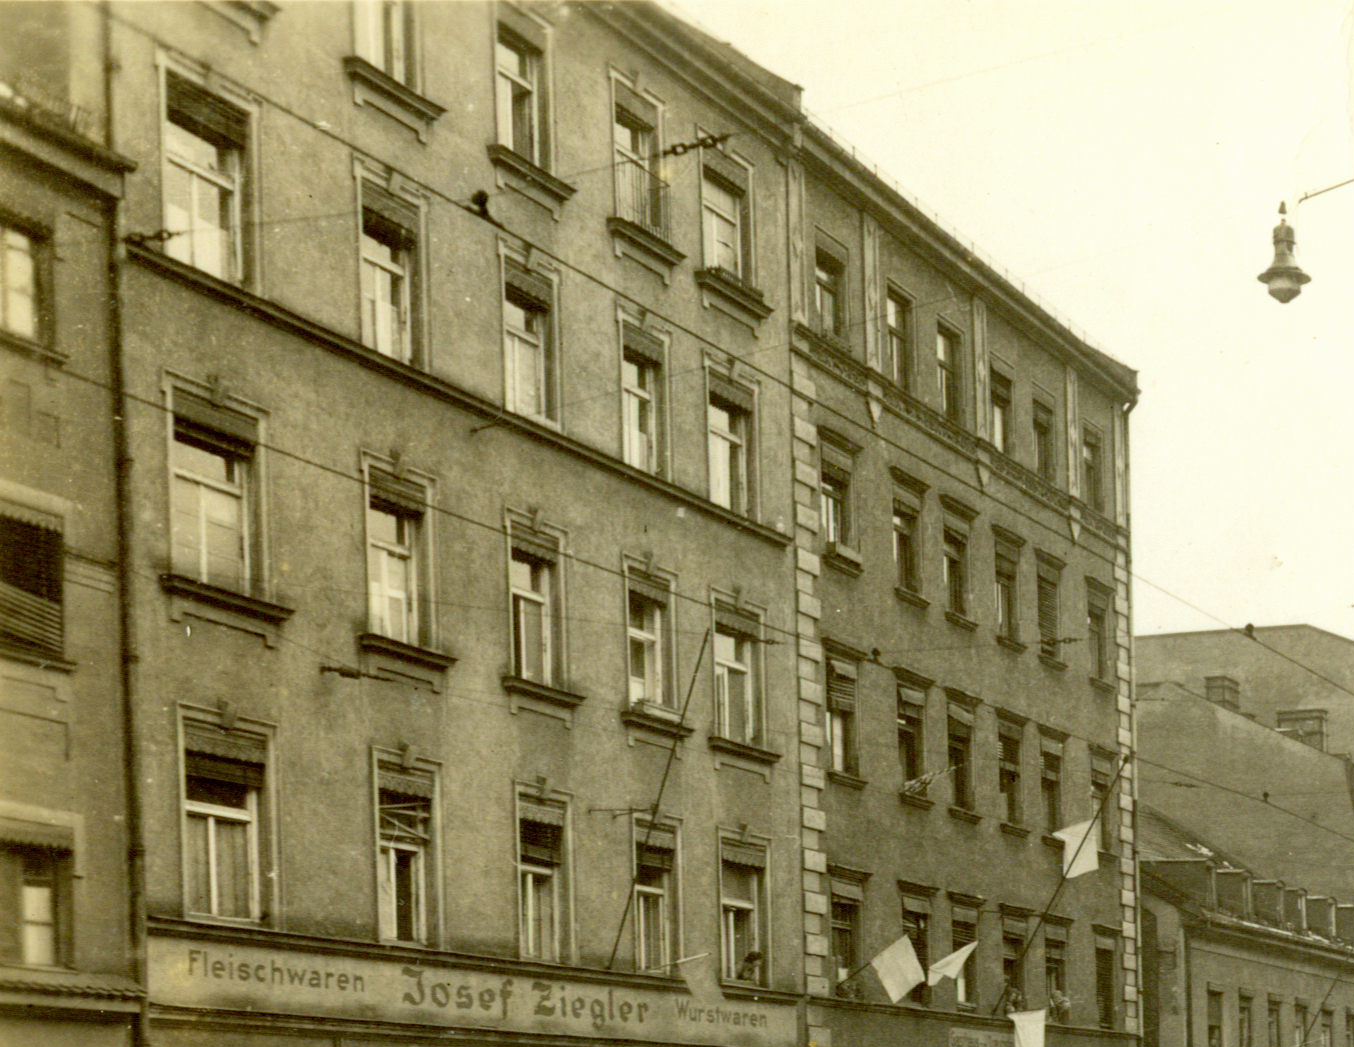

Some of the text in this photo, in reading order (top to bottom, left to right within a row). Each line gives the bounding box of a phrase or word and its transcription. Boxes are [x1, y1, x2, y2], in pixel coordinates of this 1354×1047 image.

[188, 949, 768, 1032] Fleischwaren Josef Ziegler Wurstwaren
